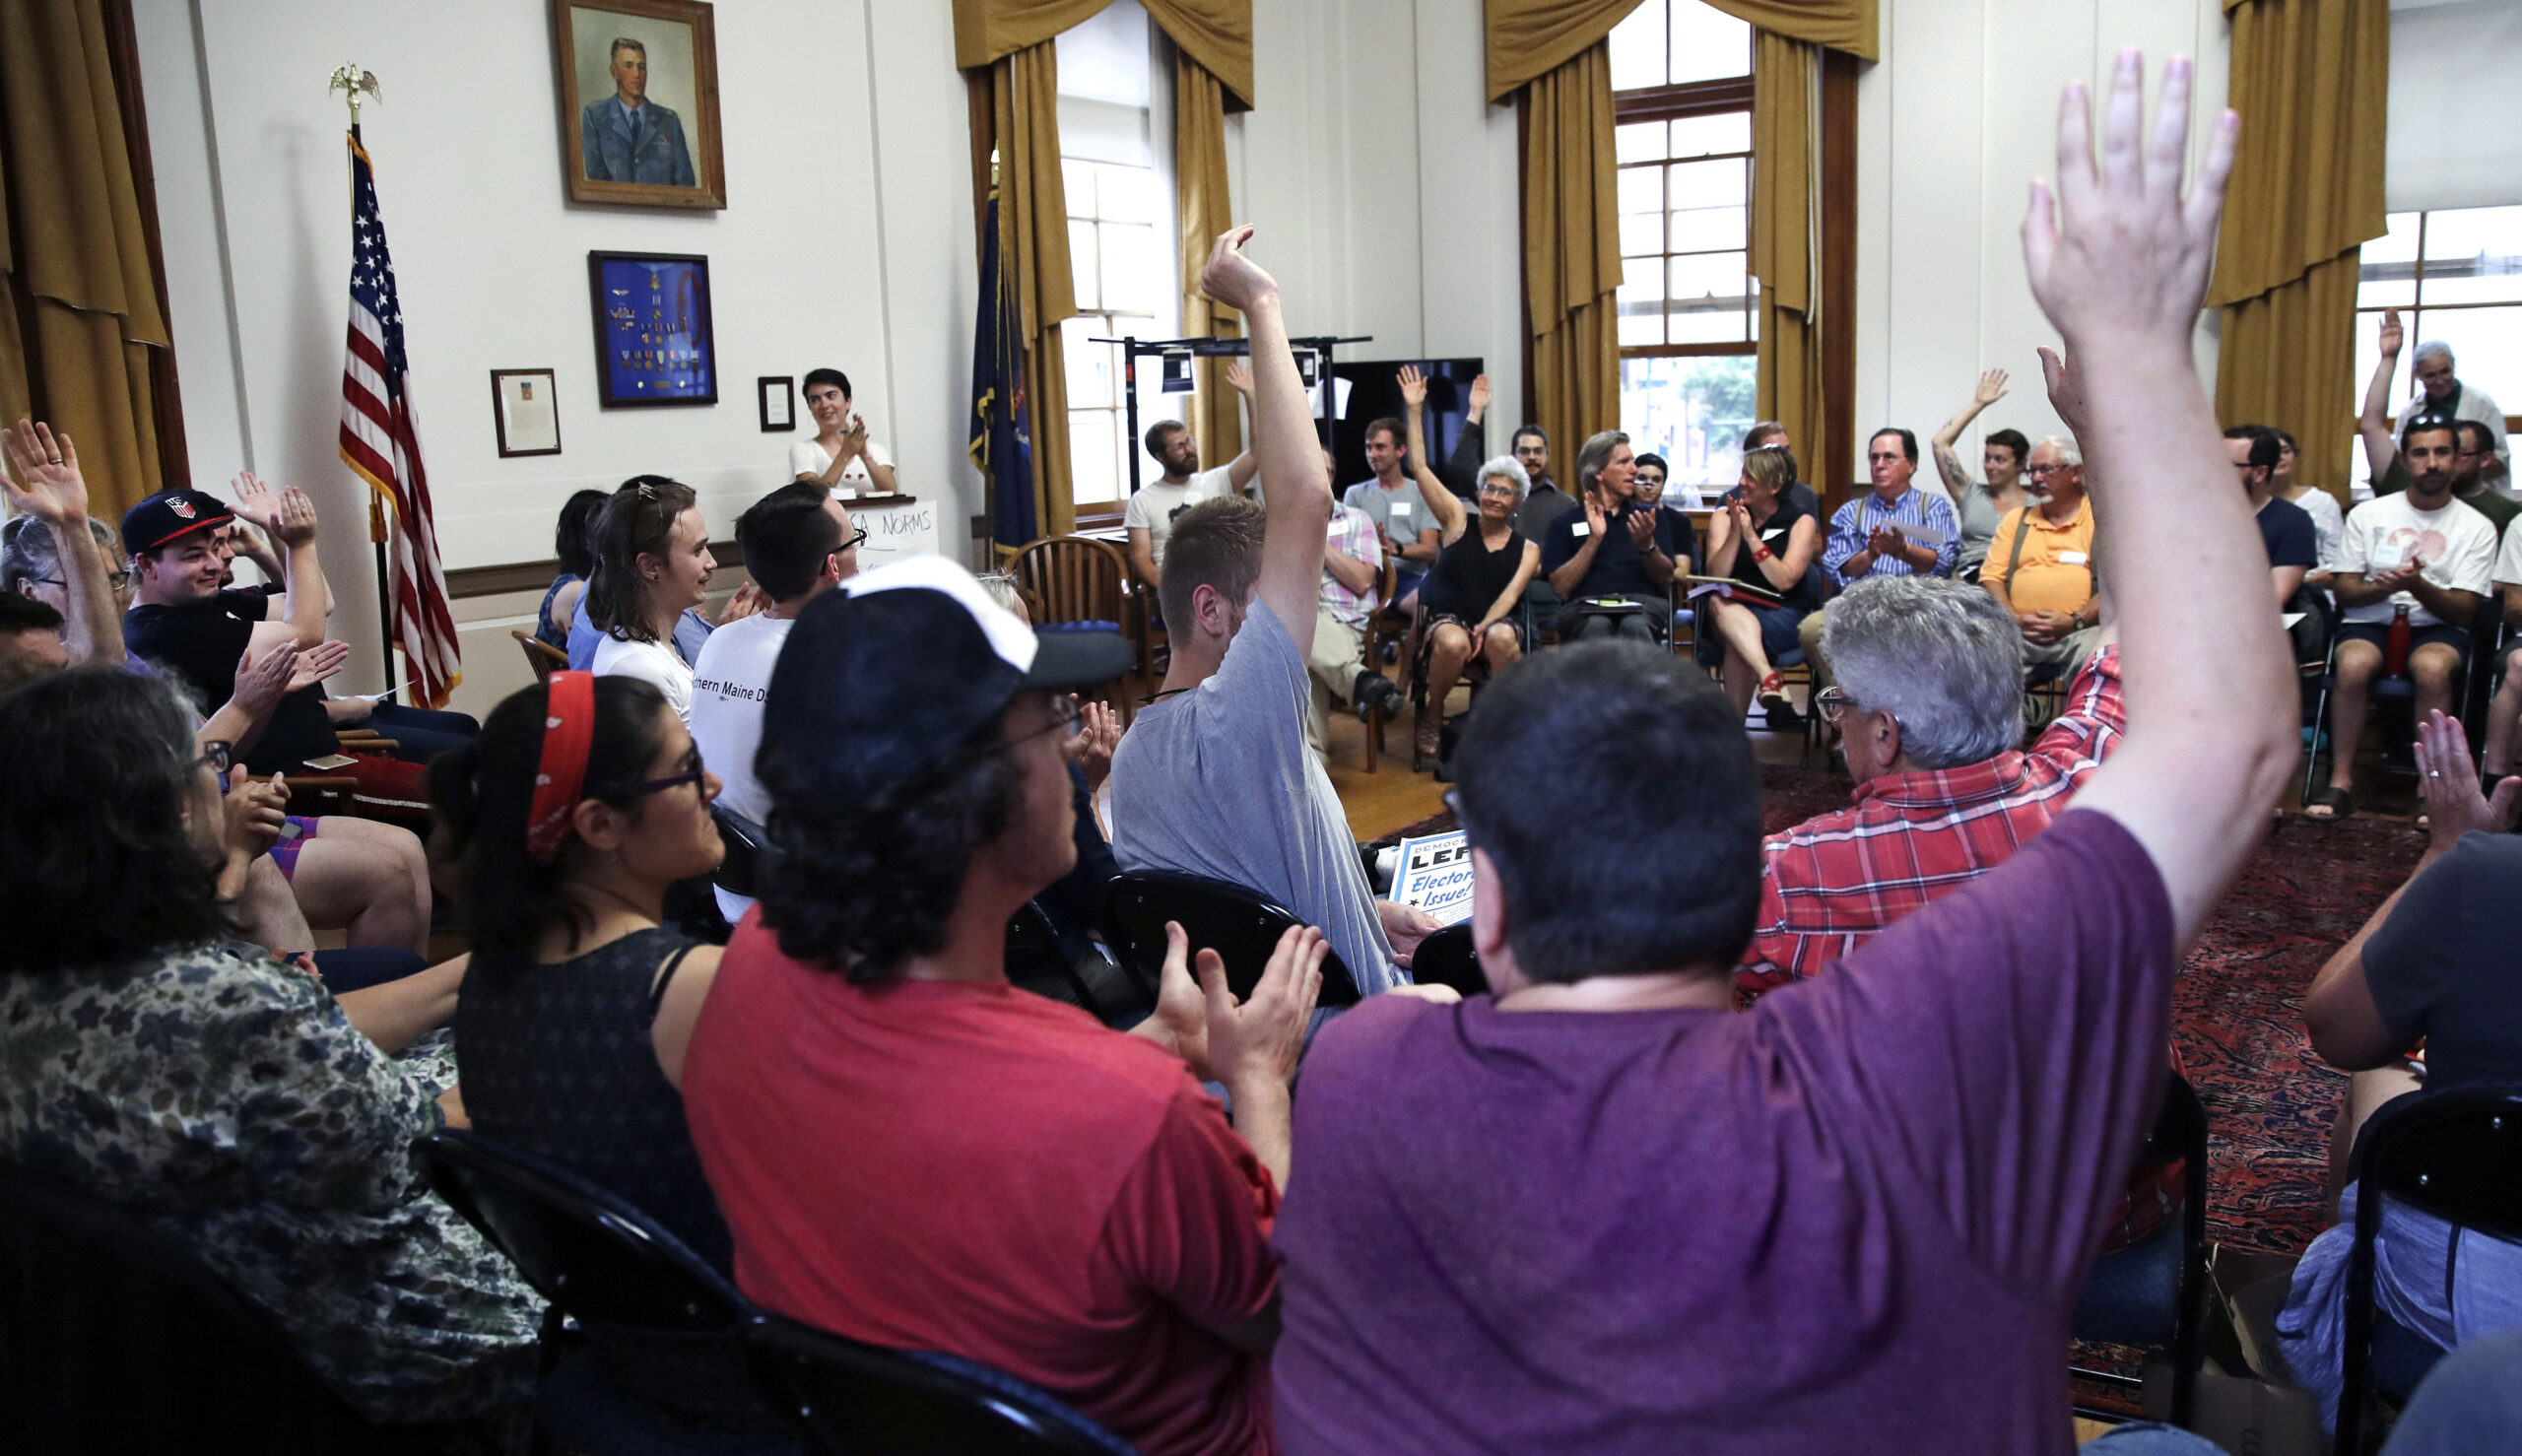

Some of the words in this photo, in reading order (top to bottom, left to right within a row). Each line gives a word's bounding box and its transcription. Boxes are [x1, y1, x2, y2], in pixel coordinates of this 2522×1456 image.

[883, 510, 931, 535] NORMS
[721, 681, 754, 699] Maine
[1423, 882, 1474, 906] Issue!
